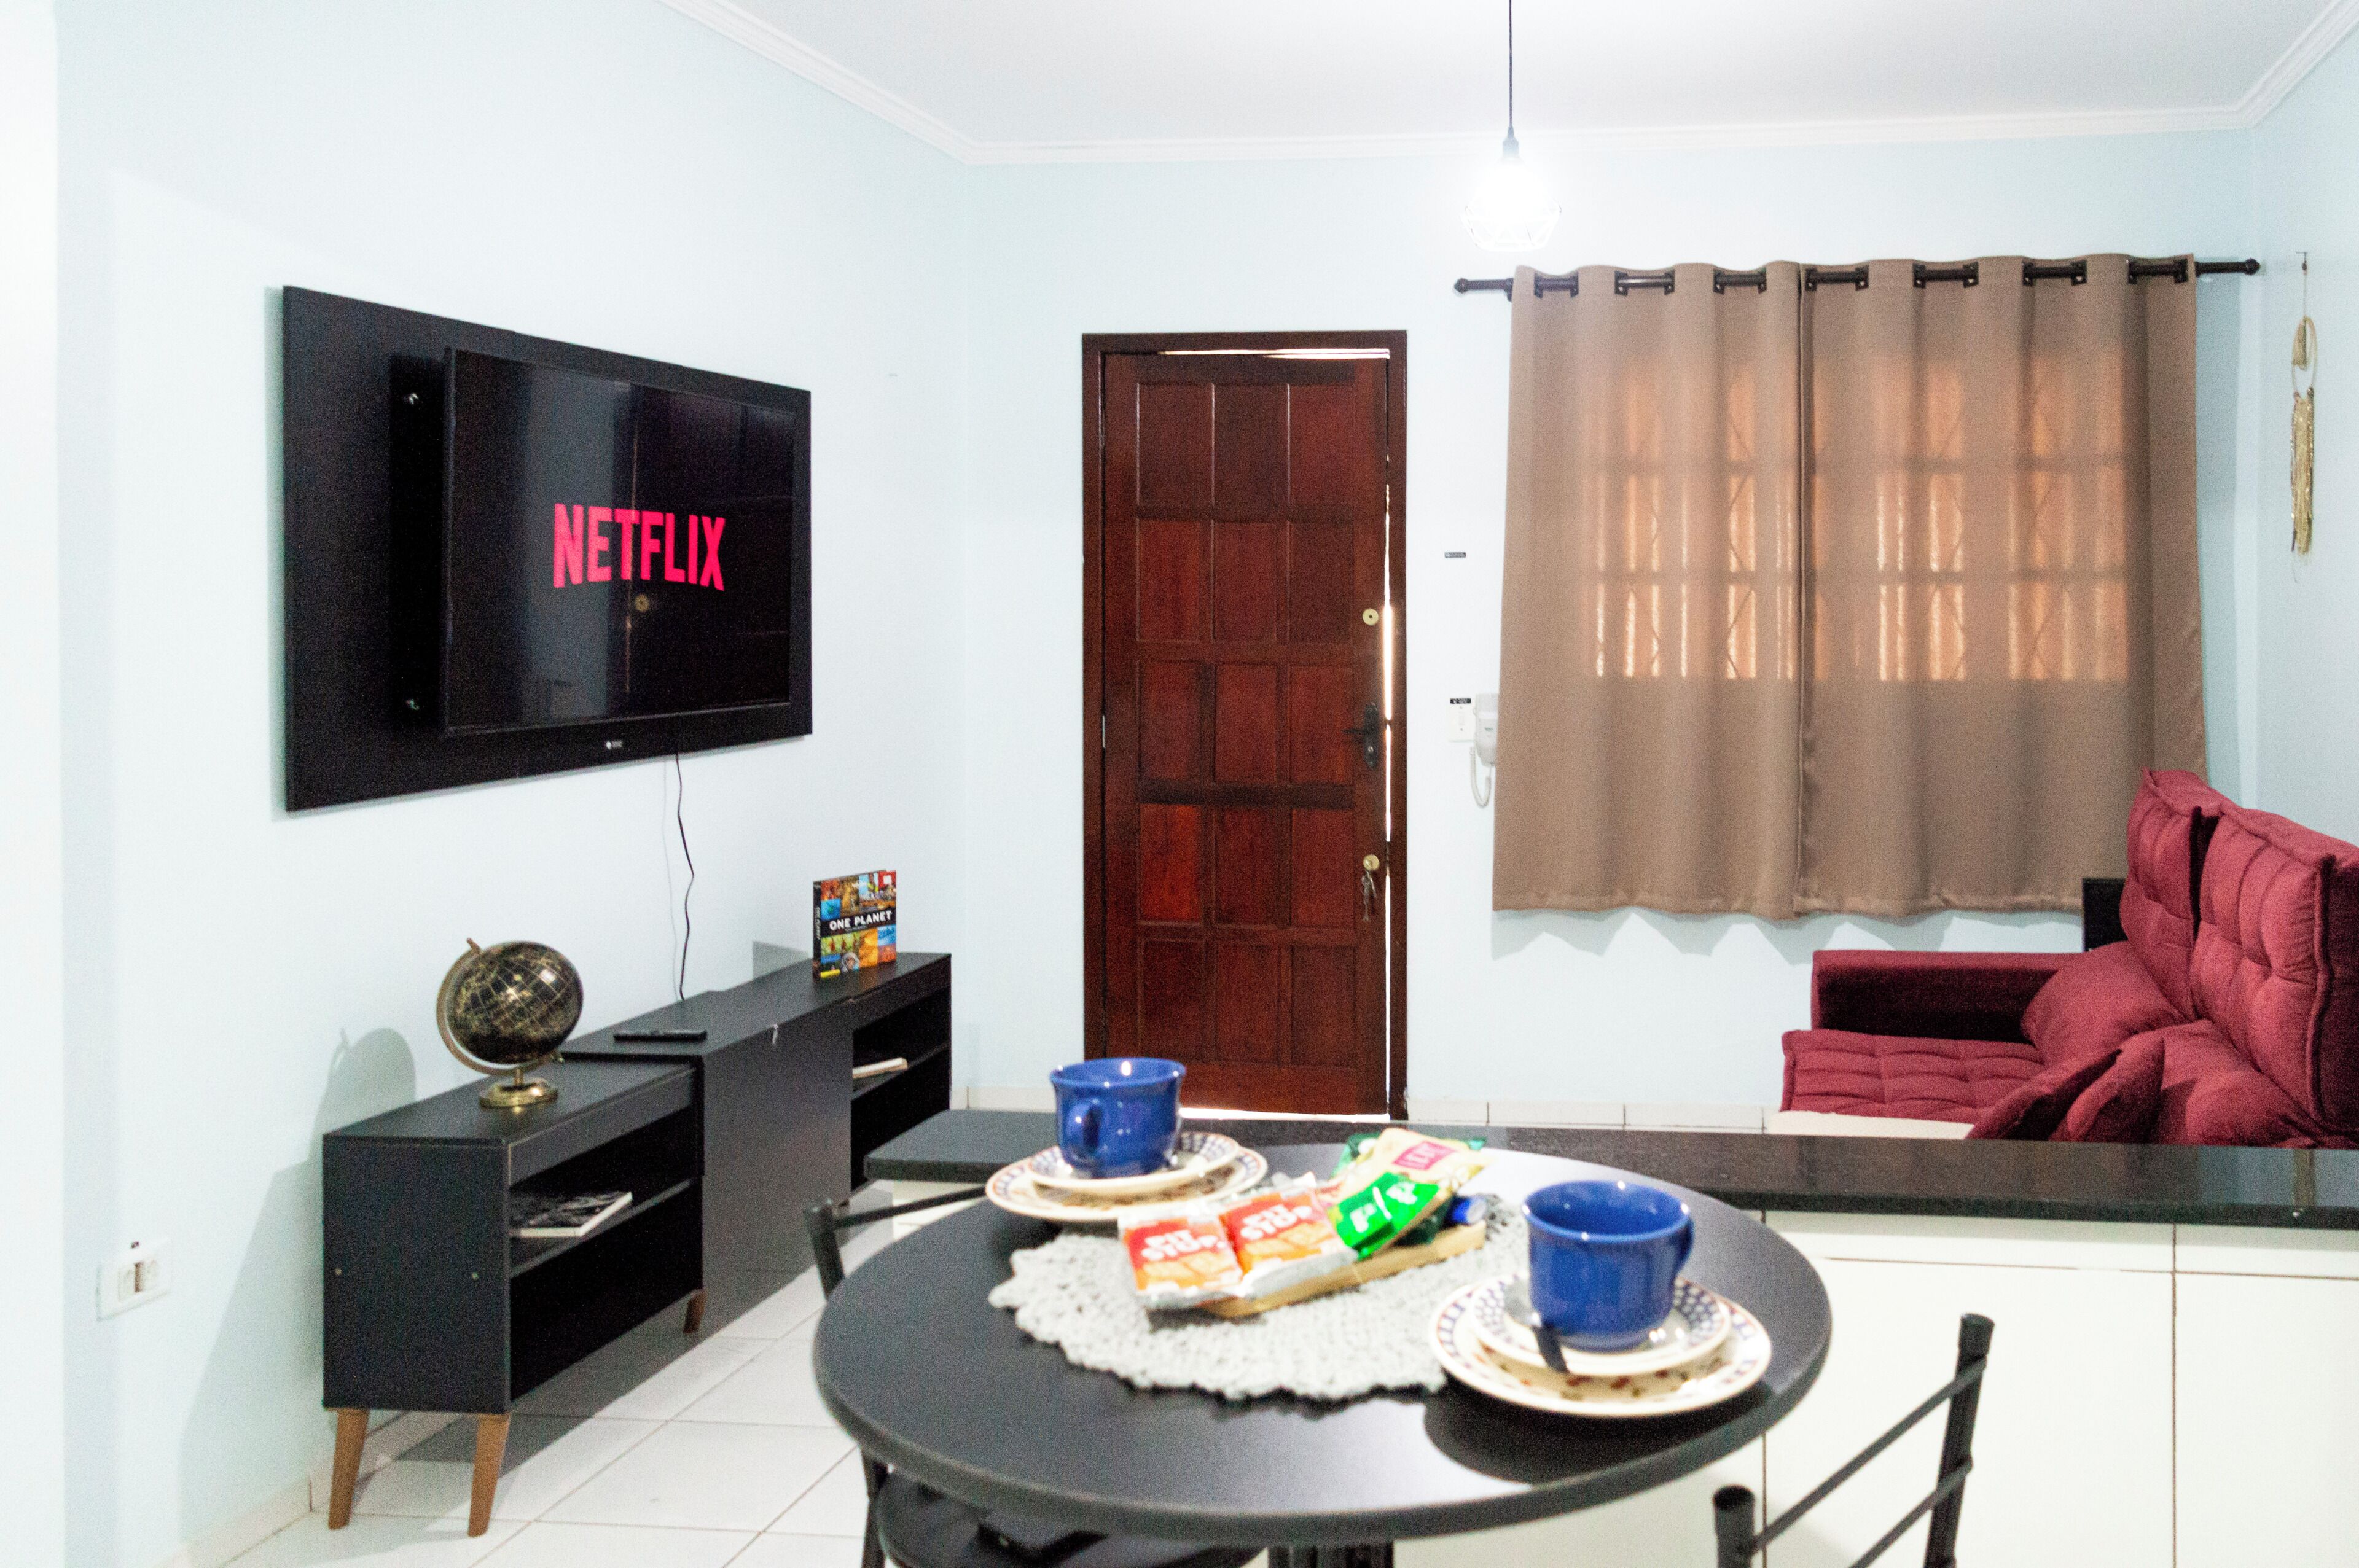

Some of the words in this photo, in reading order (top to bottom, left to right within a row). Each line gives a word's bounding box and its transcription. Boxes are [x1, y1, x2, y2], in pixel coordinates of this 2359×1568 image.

[553, 503, 726, 591] NETFLIX
[829, 918, 851, 930] ONE
[854, 910, 893, 926] PLANET
